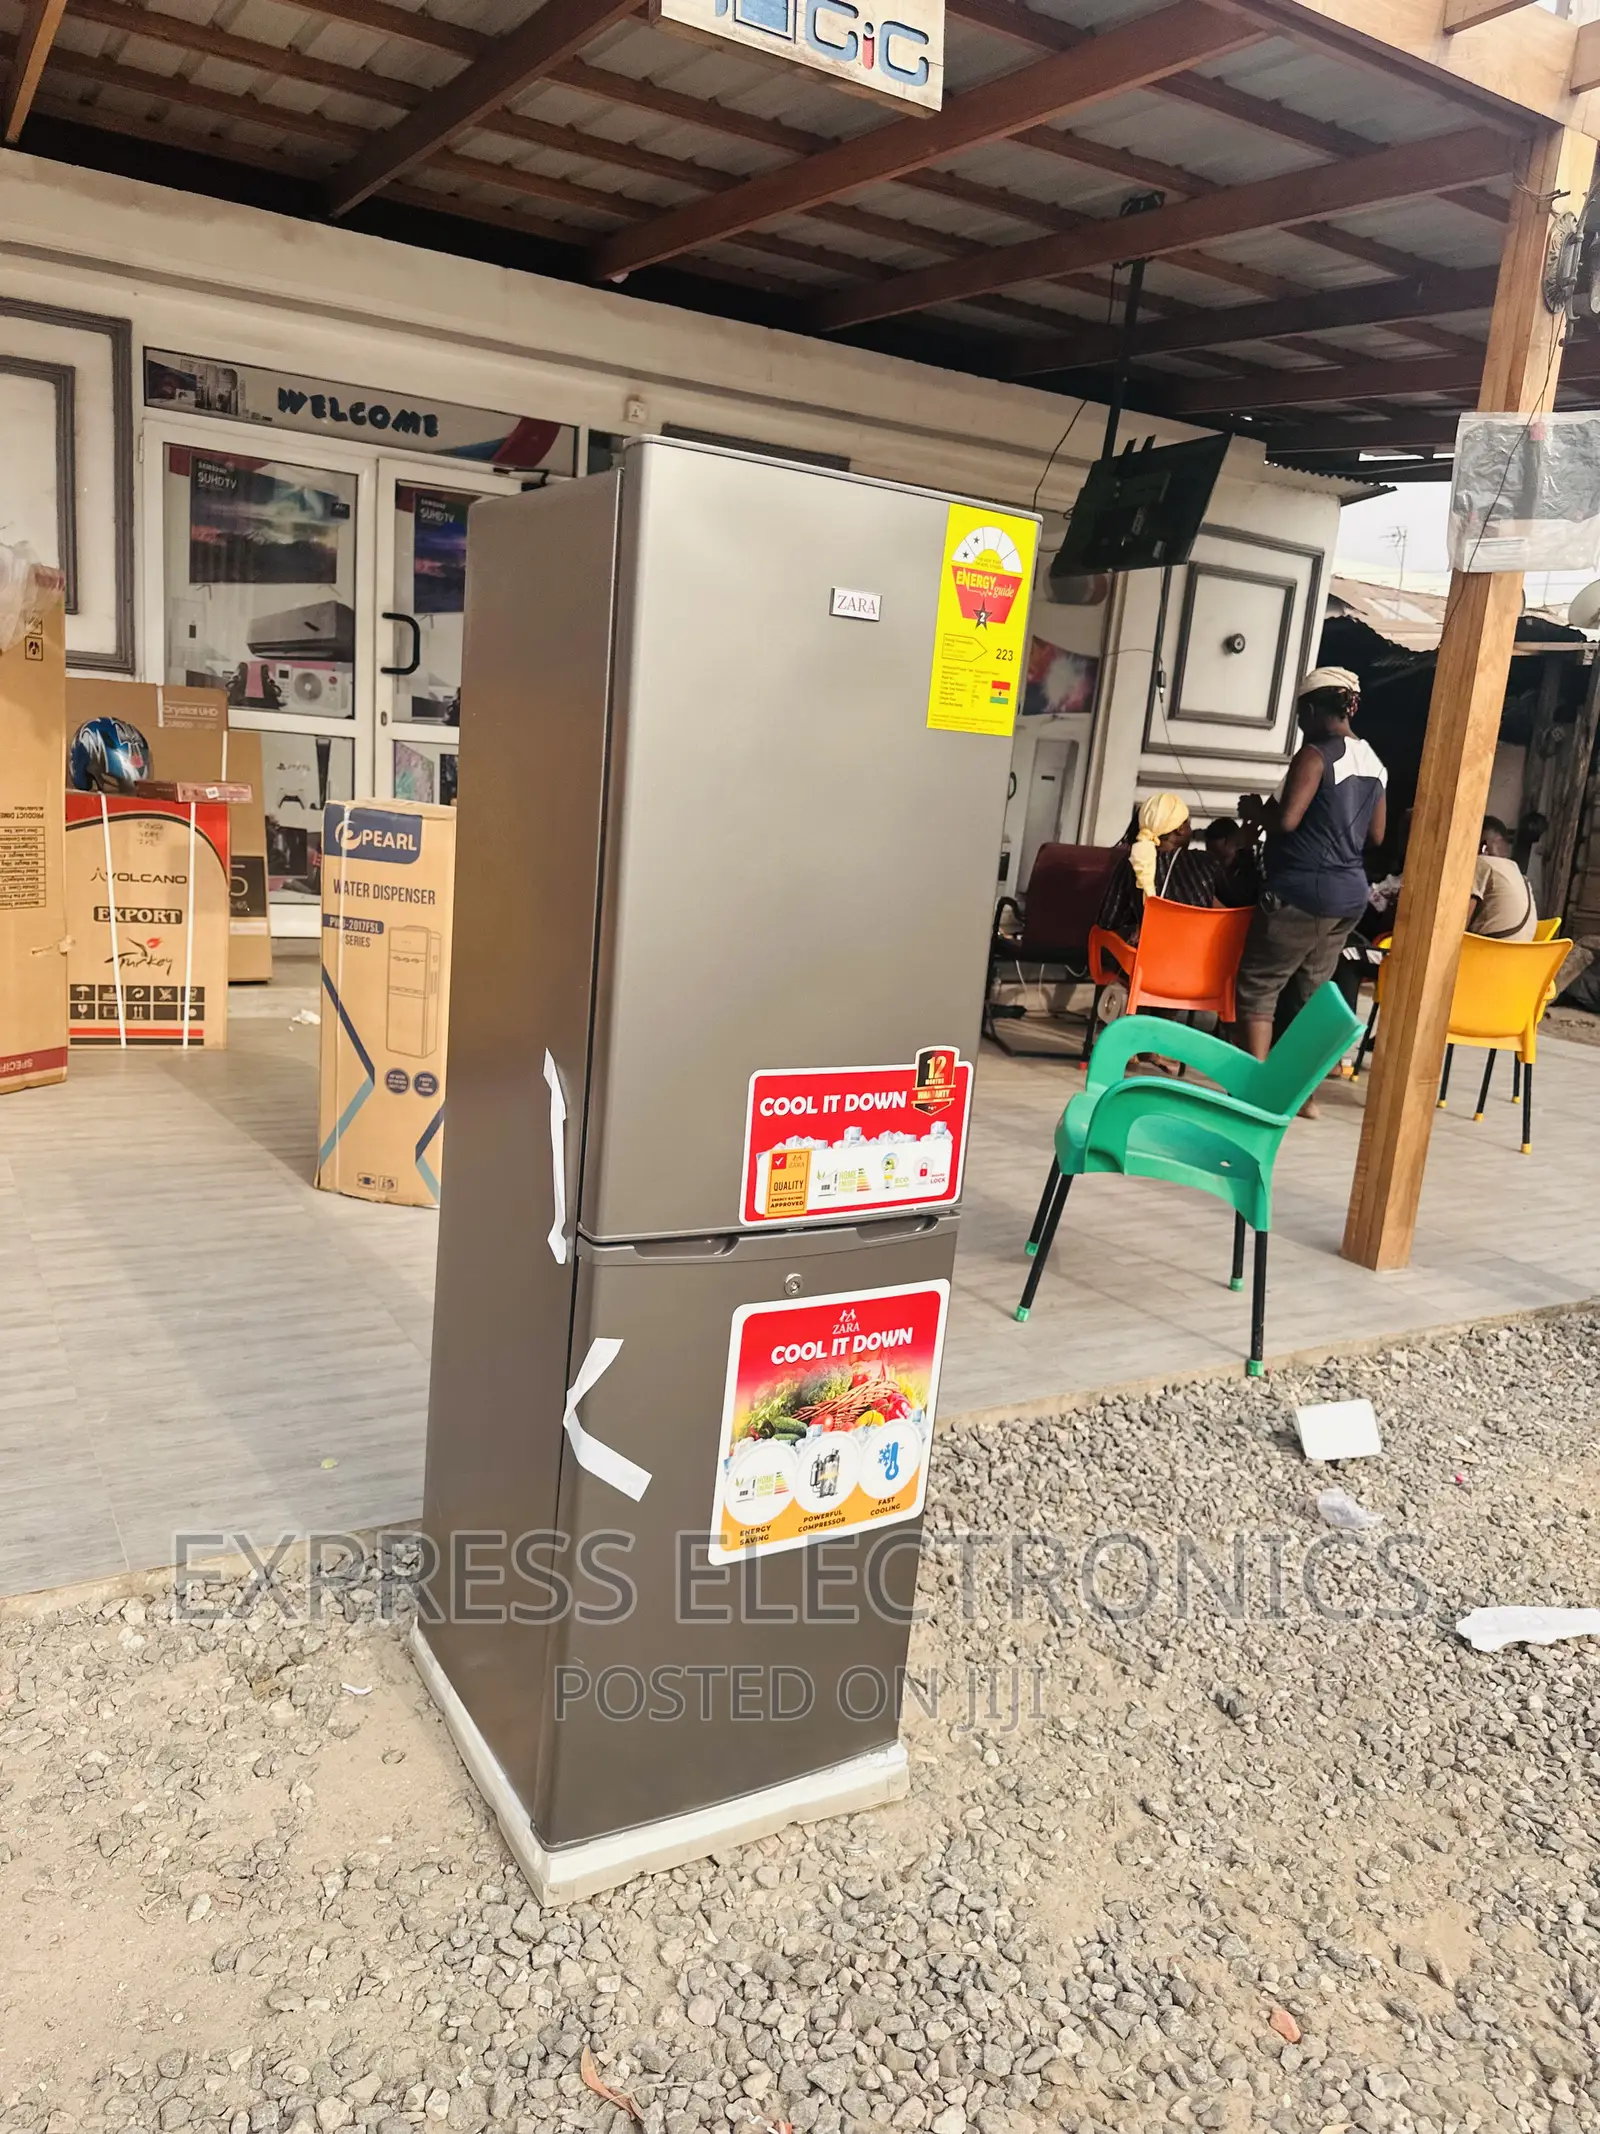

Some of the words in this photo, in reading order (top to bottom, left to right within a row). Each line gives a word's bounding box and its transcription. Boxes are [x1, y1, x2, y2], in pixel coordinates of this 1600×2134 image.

[277, 387, 439, 437] WELCOME
[955, 567, 997, 592] ENERGY
[992, 583, 1015, 599] guide
[837, 594, 877, 615] ZARA
[995, 648, 1014, 662] 223
[362, 829, 418, 852] PEARL
[105, 872, 187, 884] VOLCANO
[333, 878, 370, 899] WATER
[372, 884, 436, 905] DISPENSER
[97, 907, 180, 923] EXPORT
[345, 934, 371, 948] SERIES
[926, 1055, 947, 1079] 12
[759, 1096, 818, 1117] COOL
[822, 1094, 841, 1114] IT
[844, 1091, 907, 1112] DOWN
[773, 1180, 804, 1192] QUALITY
[770, 1200, 804, 1208] APPROVED
[832, 1321, 860, 1335] ZARA
[770, 1340, 827, 1366] COOL
[831, 1336, 850, 1357] IT
[852, 1326, 914, 1354] DOWN
[878, 1496, 896, 1506] FAST
[803, 1509, 843, 1523] POWERFUL
[870, 1503, 901, 1516] COOLING
[739, 1524, 772, 1537] ENERGY
[797, 1516, 846, 1533] COMPRESSOR
[739, 1534, 770, 1546] SAVING
